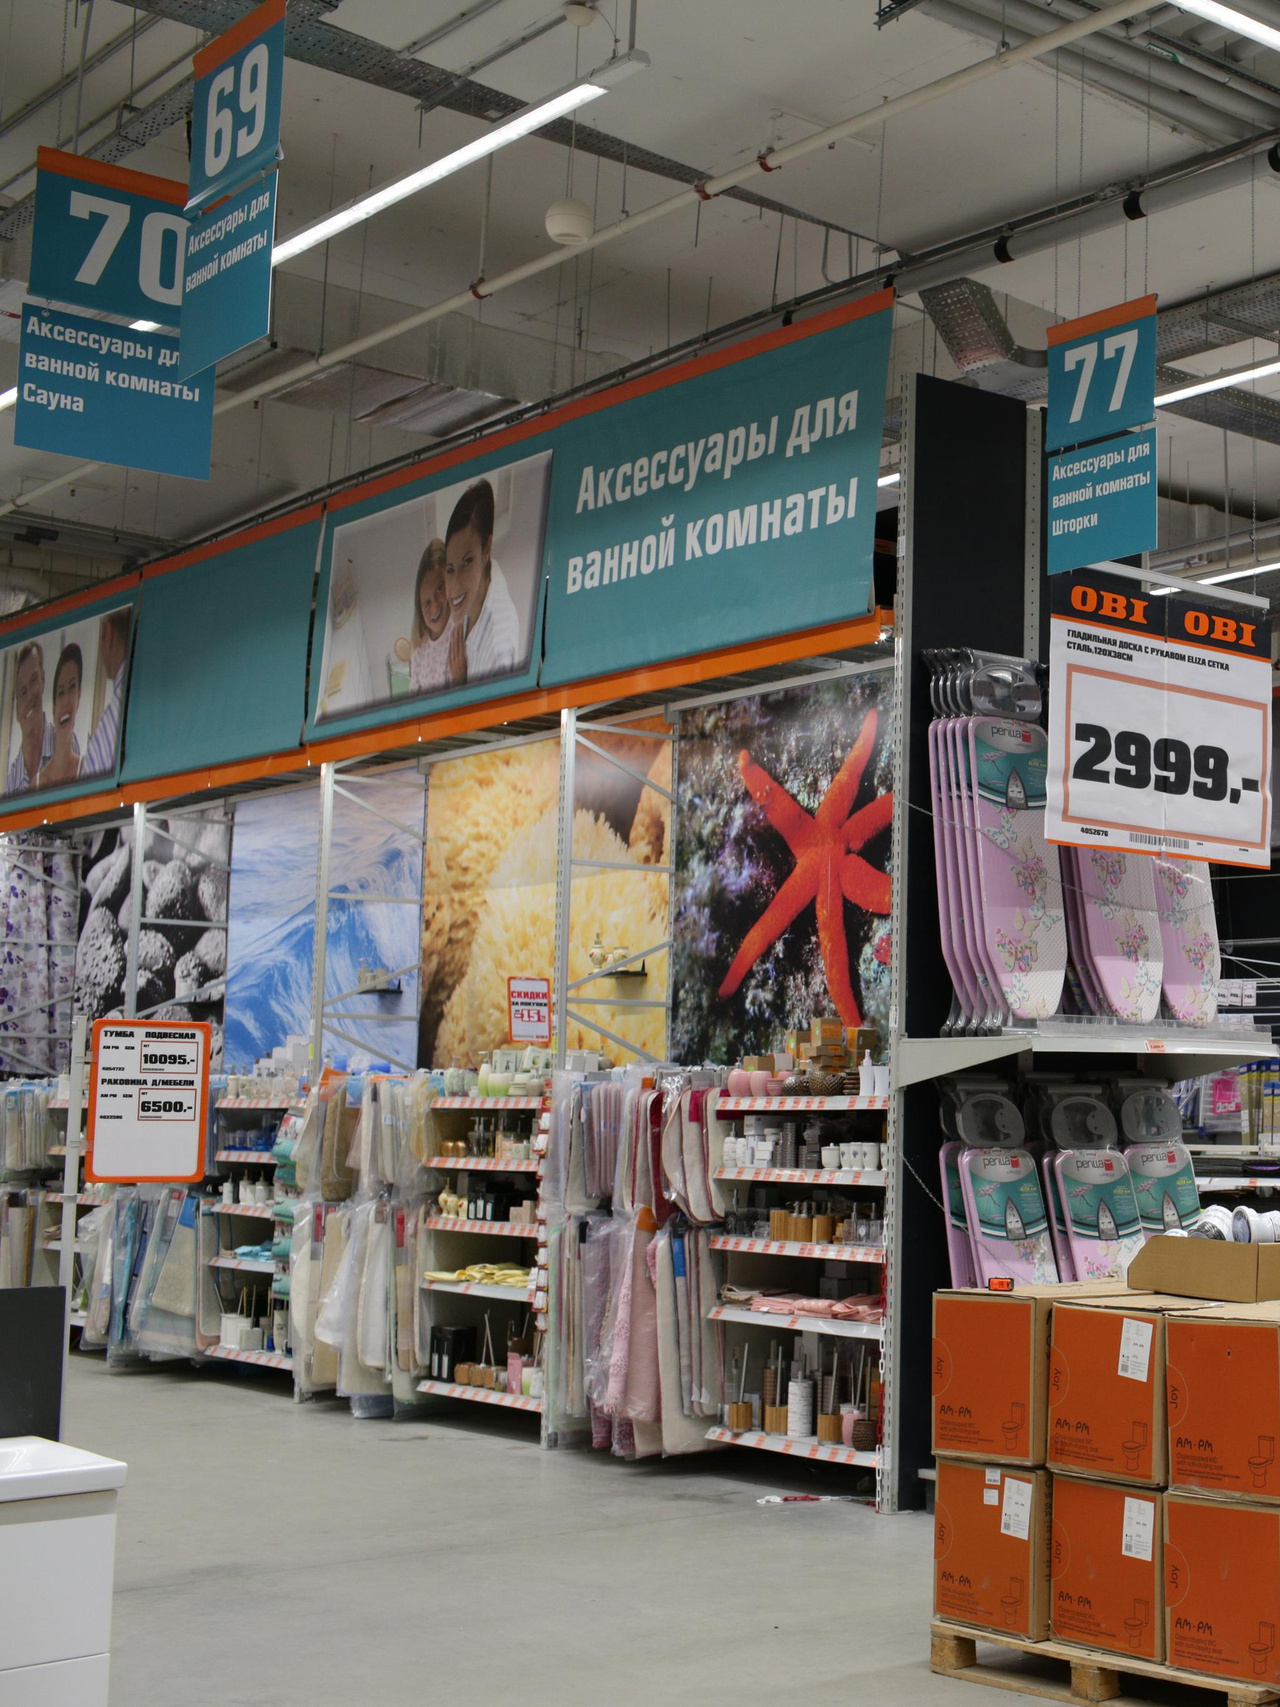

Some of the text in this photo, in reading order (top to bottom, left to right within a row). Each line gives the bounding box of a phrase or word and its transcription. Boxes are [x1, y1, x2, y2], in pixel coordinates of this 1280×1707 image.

[204, 43, 269, 177] 69
[188, 191, 270, 257] Аксессуары для
[69, 190, 183, 306] 70
[186, 229, 268, 293] ванной комнаты
[26, 315, 180, 367] Аксессуары дл
[25, 352, 200, 402] ванной комнаты
[1064, 328, 1139, 424] 77
[23, 382, 84, 413] Сауна
[575, 389, 860, 514] Аксессуары для
[1053, 442, 1150, 482] Аксессуары для
[1053, 470, 1150, 509] ванной комнаты
[566, 476, 859, 597] ванной комнаты
[1053, 512, 1098, 537] Шторки
[1070, 584, 1149, 625] OBI
[1184, 610, 1256, 647] OBI
[1067, 629, 1117, 647] ГЛАДИЛЬНАЯ
[1118, 640, 1143, 653] ДОСКА
[1150, 647, 1186, 662] РУКАВОМ
[1187, 655, 1206, 667] ELIZA
[1207, 659, 1230, 671] СЕТКА
[510, 991, 547, 1000] СКИДКИ
[103, 1030, 196, 1040] ТУМБА ПОДВЕСНАЯ
[101, 1078, 147, 1086] РАКОВИНА
